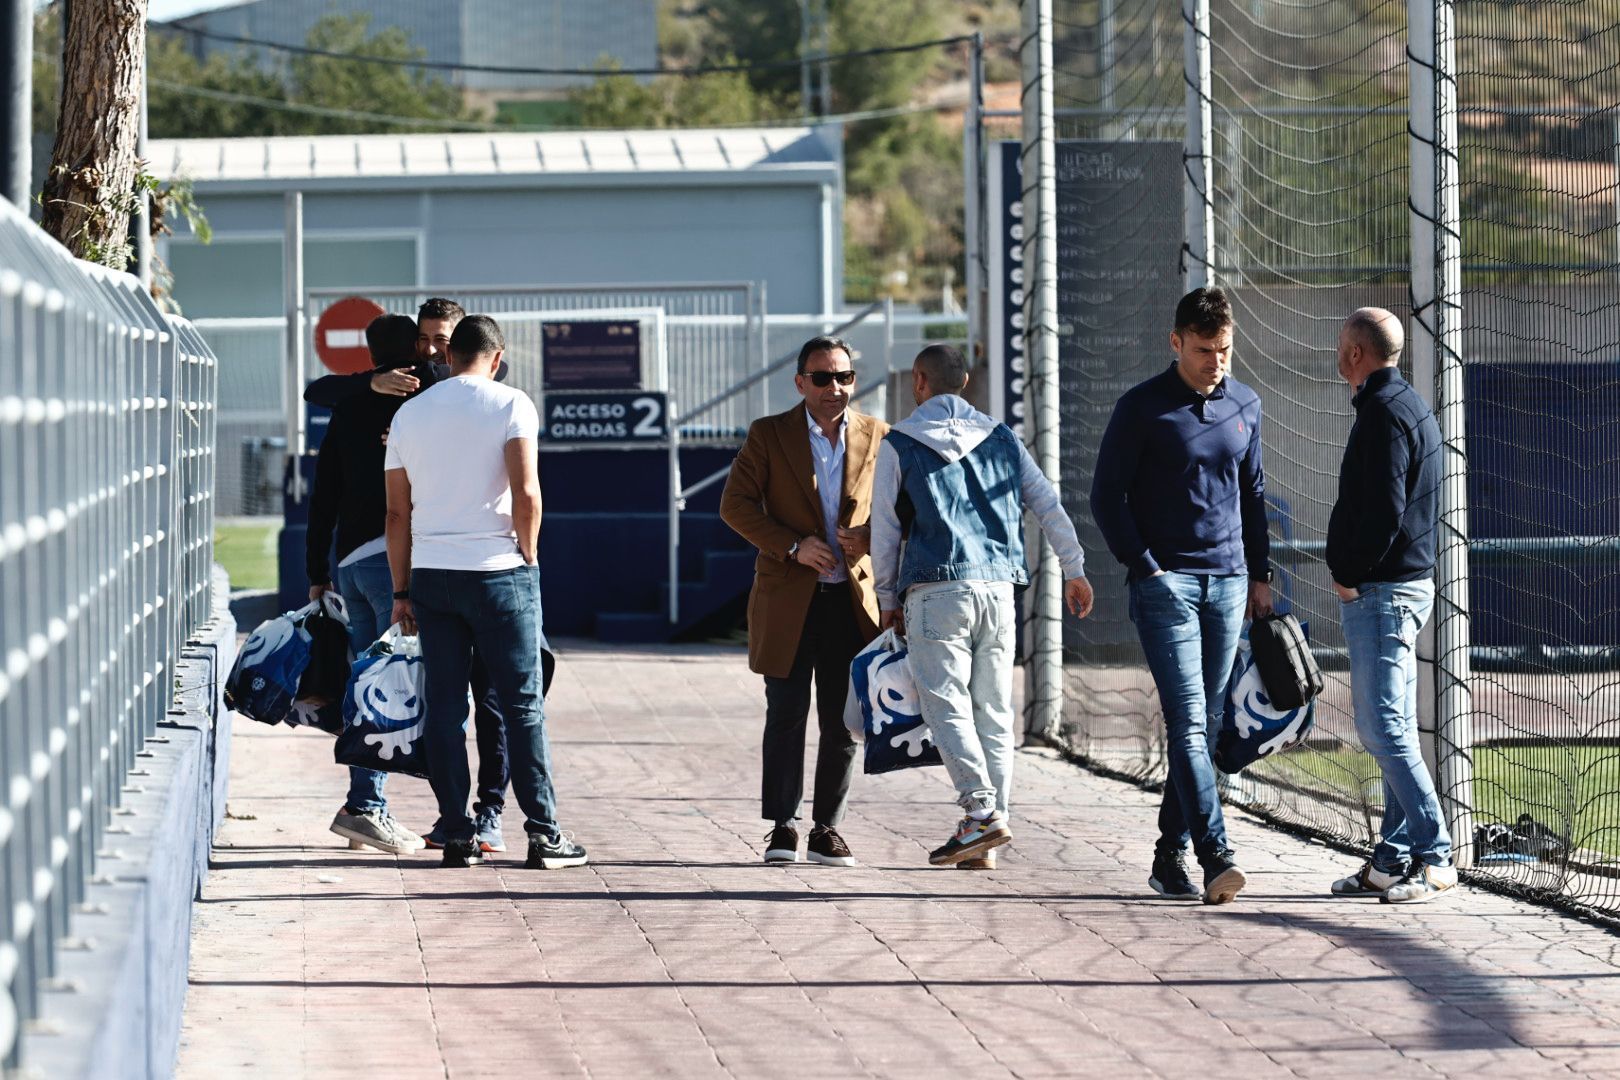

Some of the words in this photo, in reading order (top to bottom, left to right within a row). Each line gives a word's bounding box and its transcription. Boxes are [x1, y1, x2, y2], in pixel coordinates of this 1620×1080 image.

[551, 404, 626, 419] ACCESO
[632, 397, 663, 437] 2
[550, 423, 627, 438] GRADAS
